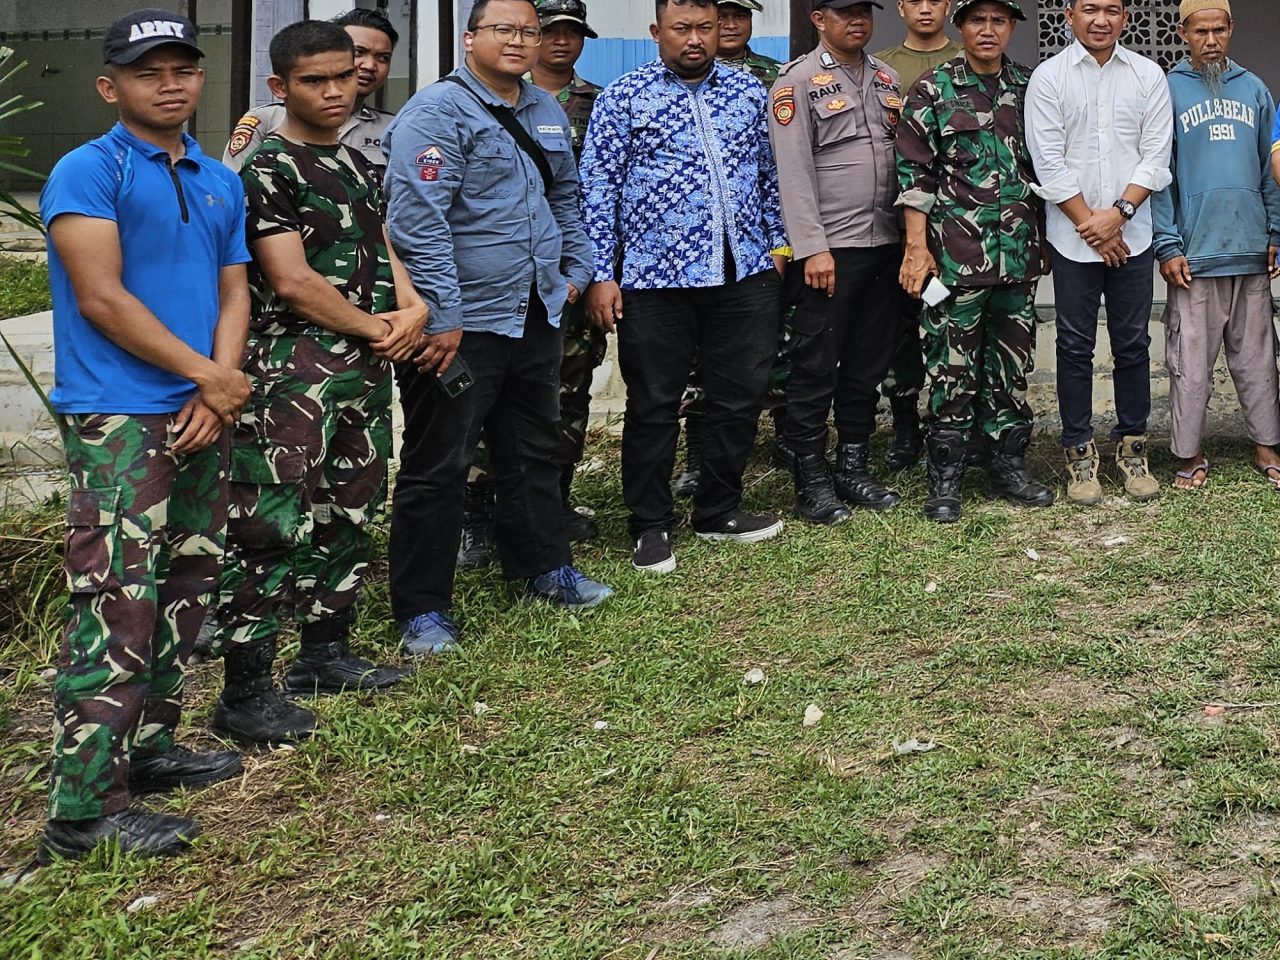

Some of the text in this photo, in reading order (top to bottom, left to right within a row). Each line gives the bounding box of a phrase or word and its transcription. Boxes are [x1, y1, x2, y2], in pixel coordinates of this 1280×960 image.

[129, 20, 184, 43] ARMY
[809, 83, 844, 101] RAUF
[1180, 98, 1255, 134] PULL&BEAR
[1209, 124, 1236, 141] 1991
[364, 137, 381, 147] PO
